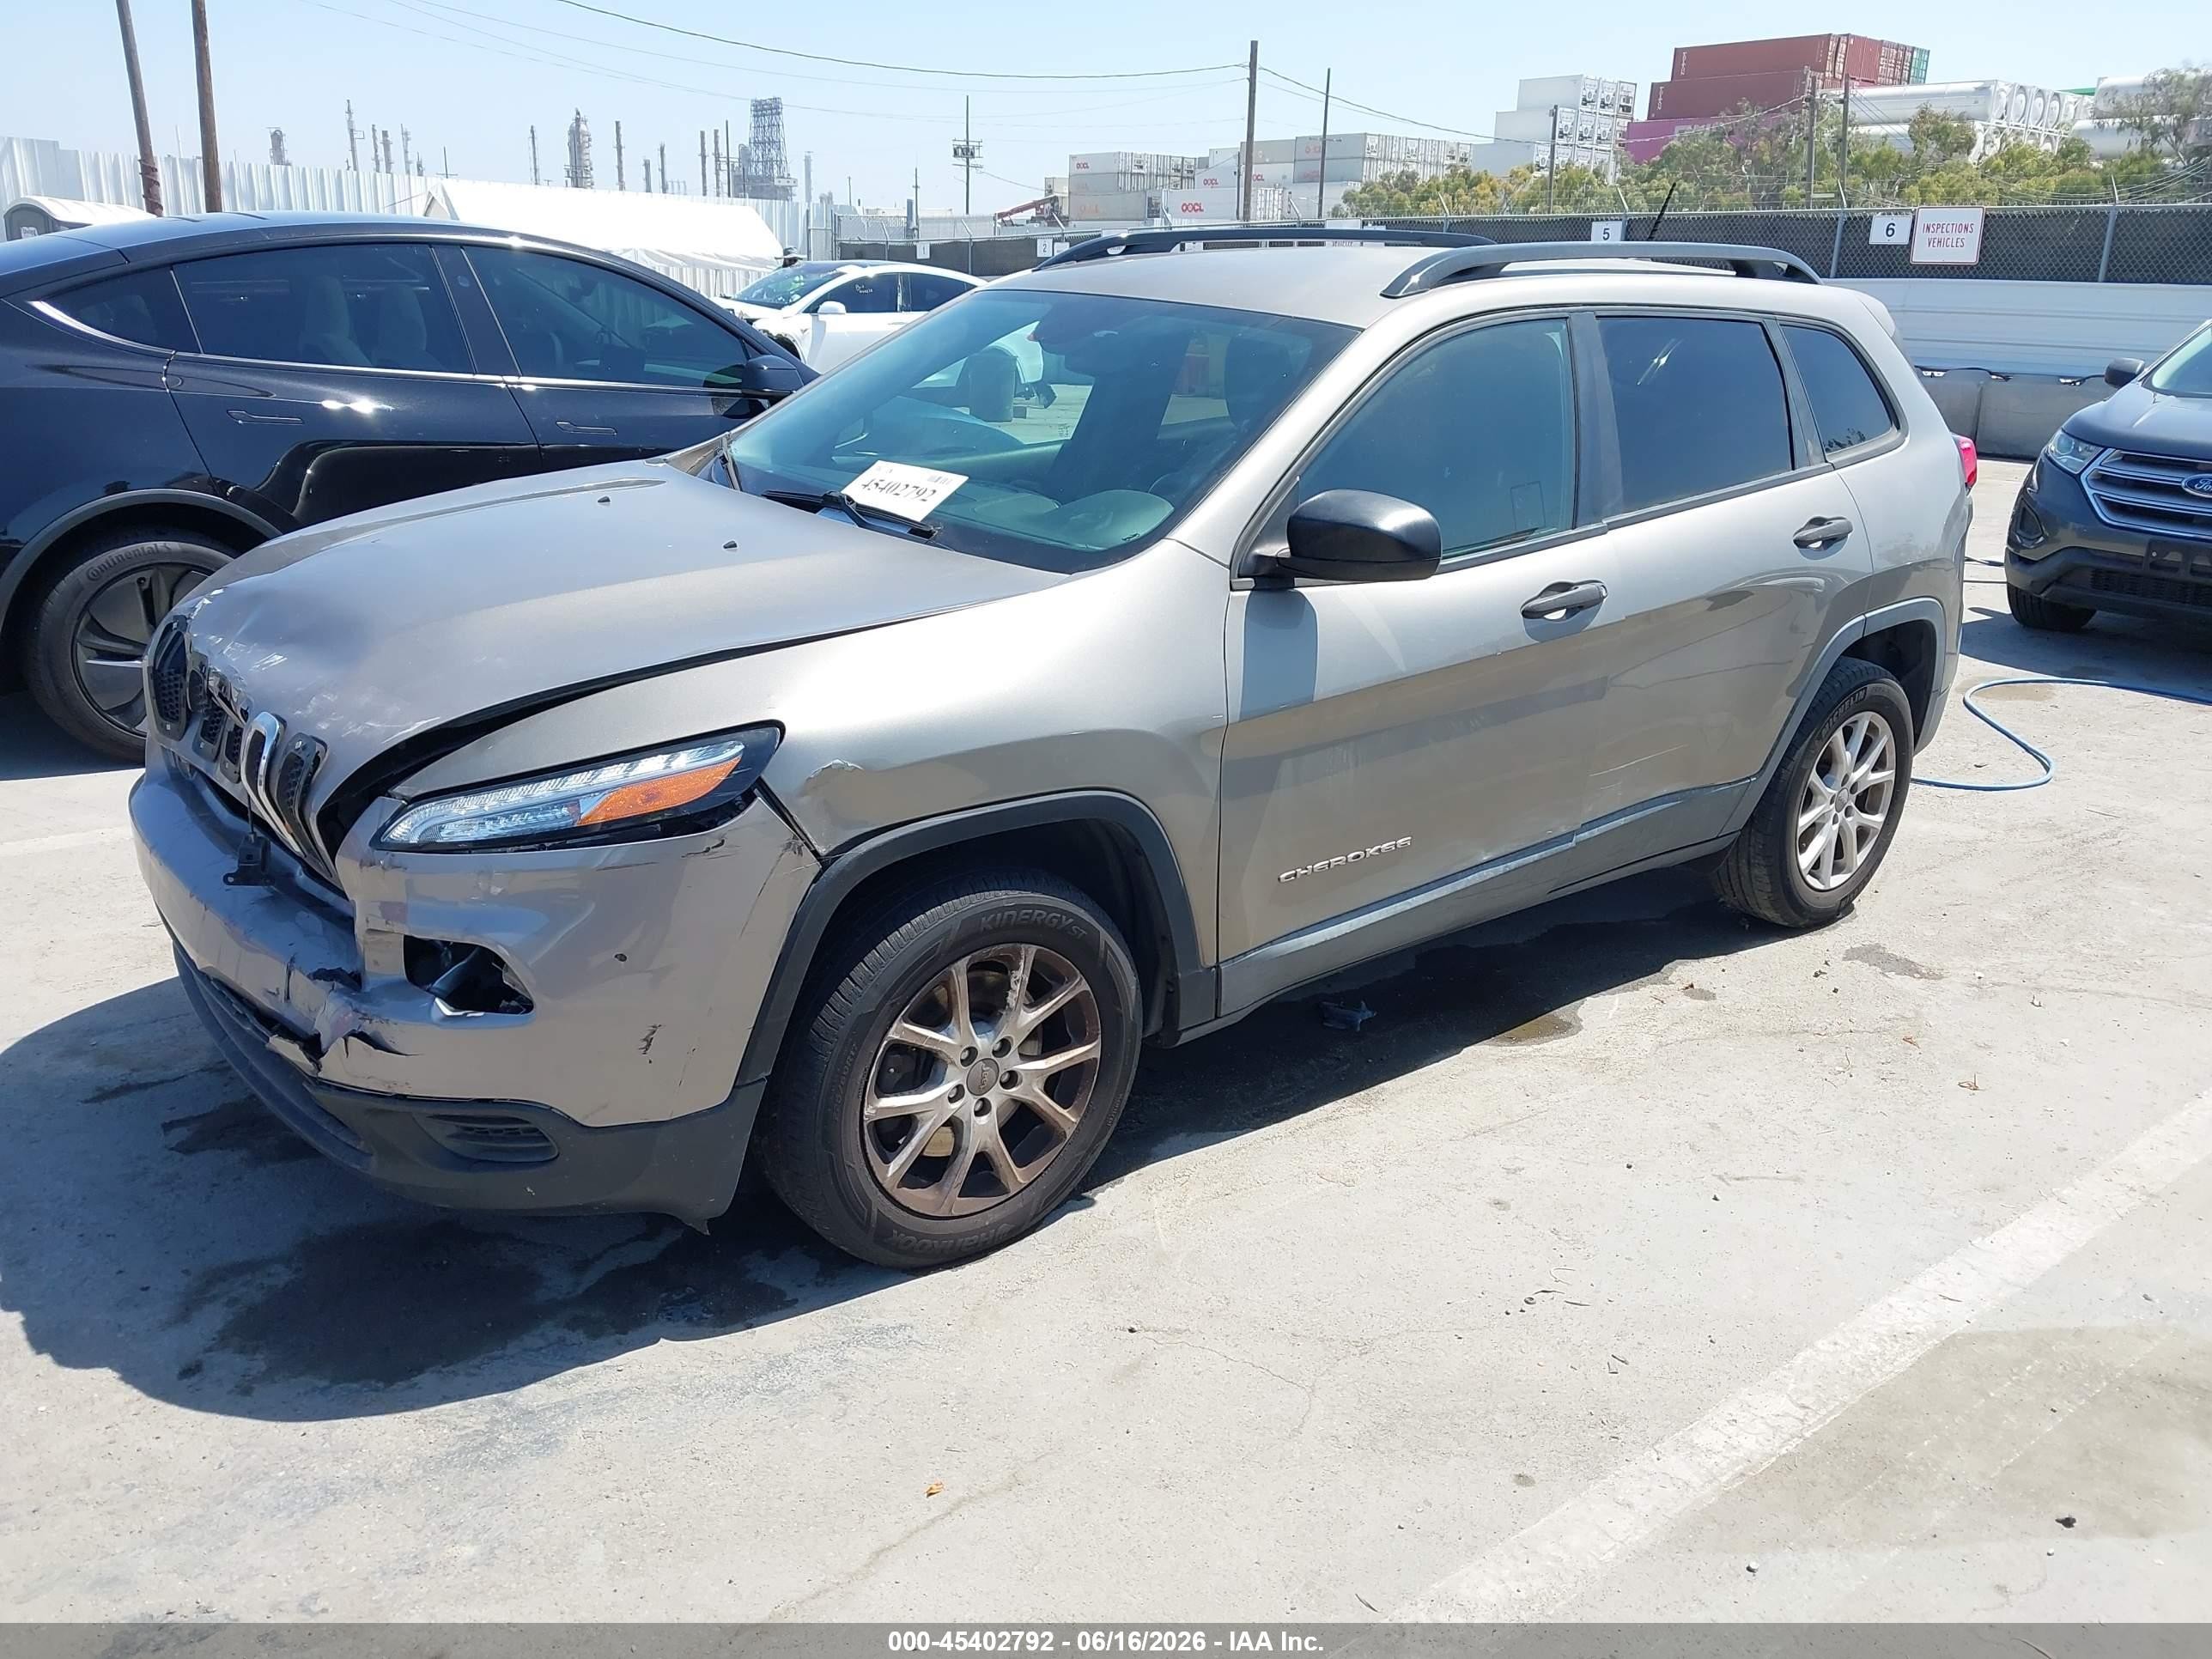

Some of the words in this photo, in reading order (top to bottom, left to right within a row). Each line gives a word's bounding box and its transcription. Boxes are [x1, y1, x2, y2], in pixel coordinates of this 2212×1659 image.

[1076, 161, 1090, 170] OOCL
[1203, 178, 1218, 186] OOCL
[1253, 173, 1265, 182] OCL
[1182, 202, 1204, 213] OOCL
[1602, 228, 1610, 240] 5
[1886, 222, 1895, 238] 6
[1922, 222, 1975, 234] INSPECTIONS
[1042, 243, 1048, 253] 2
[1928, 237, 1966, 248] VEHICLES
[861, 478, 937, 502] 45402792
[88, 543, 160, 581] Continental
[1820, 688, 1868, 739] MICHELIN
[1277, 836, 1413, 884] CHEROKEE
[981, 909, 1073, 932] KINERGY
[1068, 926, 1088, 939] ST
[979, 1060, 991, 1091] Jeep
